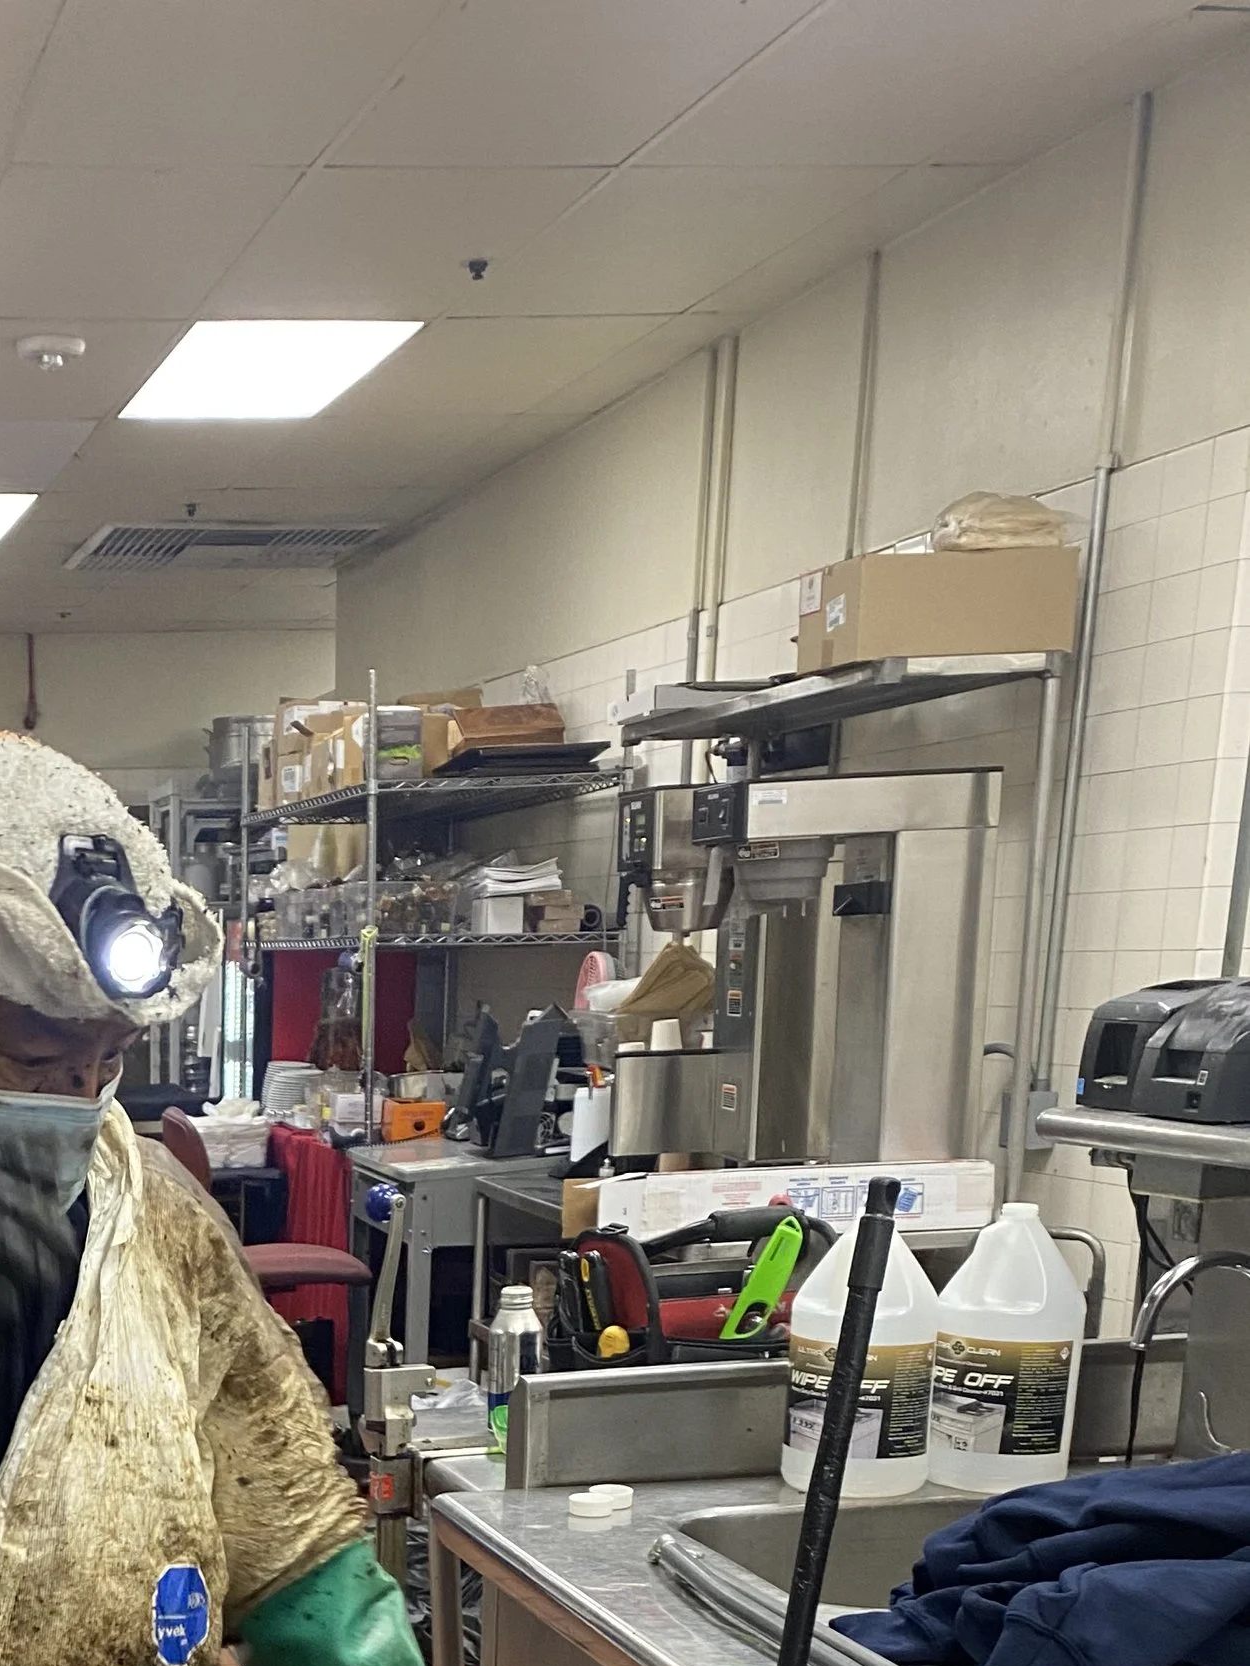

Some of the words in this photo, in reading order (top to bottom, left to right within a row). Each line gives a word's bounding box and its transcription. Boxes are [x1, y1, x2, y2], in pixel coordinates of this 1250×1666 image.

[791, 1369, 832, 1391] WIPE
[860, 1379, 891, 1394] FF
[934, 1365, 958, 1383] PE
[963, 1372, 1014, 1389] OFF
[157, 1623, 186, 1641] yvek
